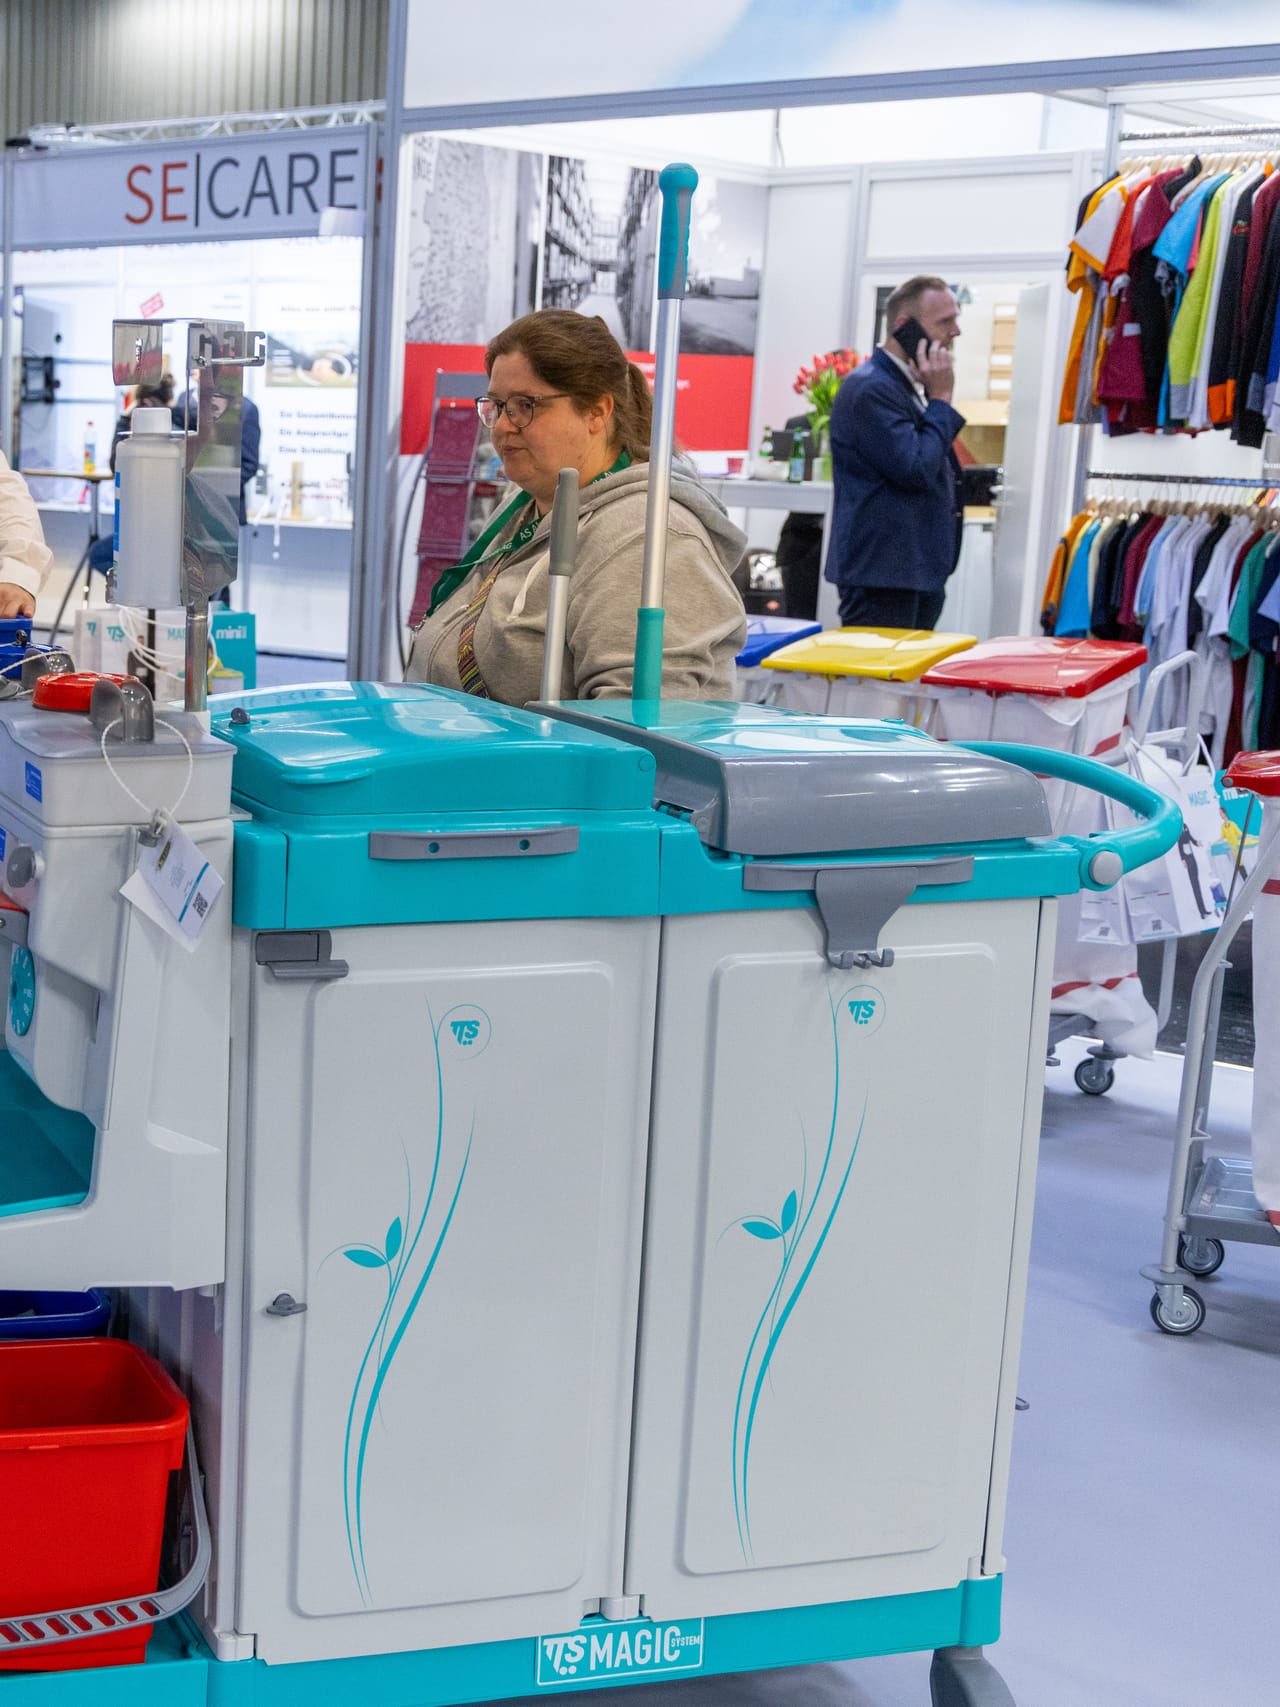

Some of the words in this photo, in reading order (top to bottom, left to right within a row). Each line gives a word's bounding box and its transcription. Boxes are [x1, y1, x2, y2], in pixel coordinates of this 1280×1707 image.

[519, 528, 532, 541] AS
[848, 1000, 876, 1025] TTS
[450, 1020, 480, 1046] TTS
[543, 1635, 587, 1676] TTS
[590, 1626, 681, 1671] MAGIC
[670, 1635, 701, 1648] SYSTEM
